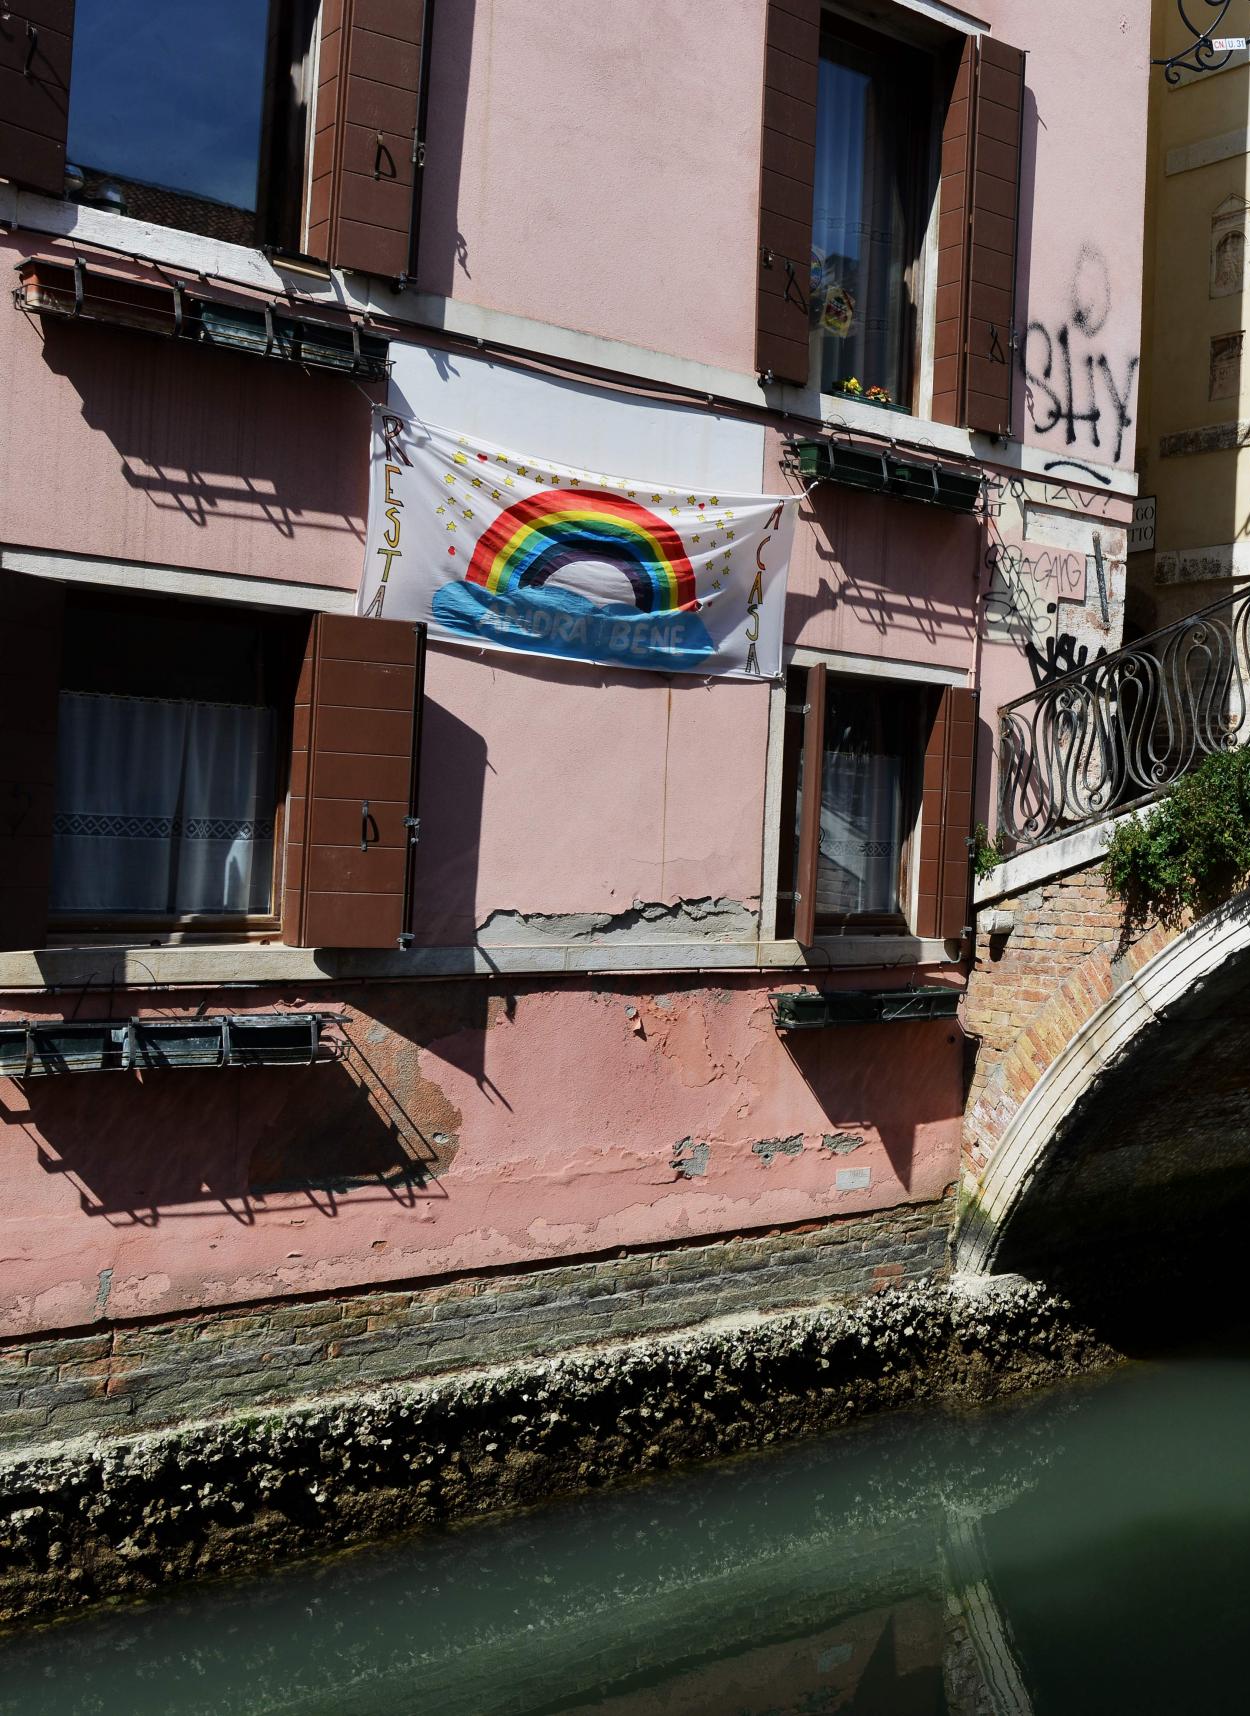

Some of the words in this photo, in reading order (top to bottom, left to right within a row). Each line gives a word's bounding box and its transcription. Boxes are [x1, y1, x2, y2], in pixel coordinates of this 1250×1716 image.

[364, 415, 414, 618] RESTA
[608, 621, 686, 656] BENE
[746, 535, 772, 675] CASA
